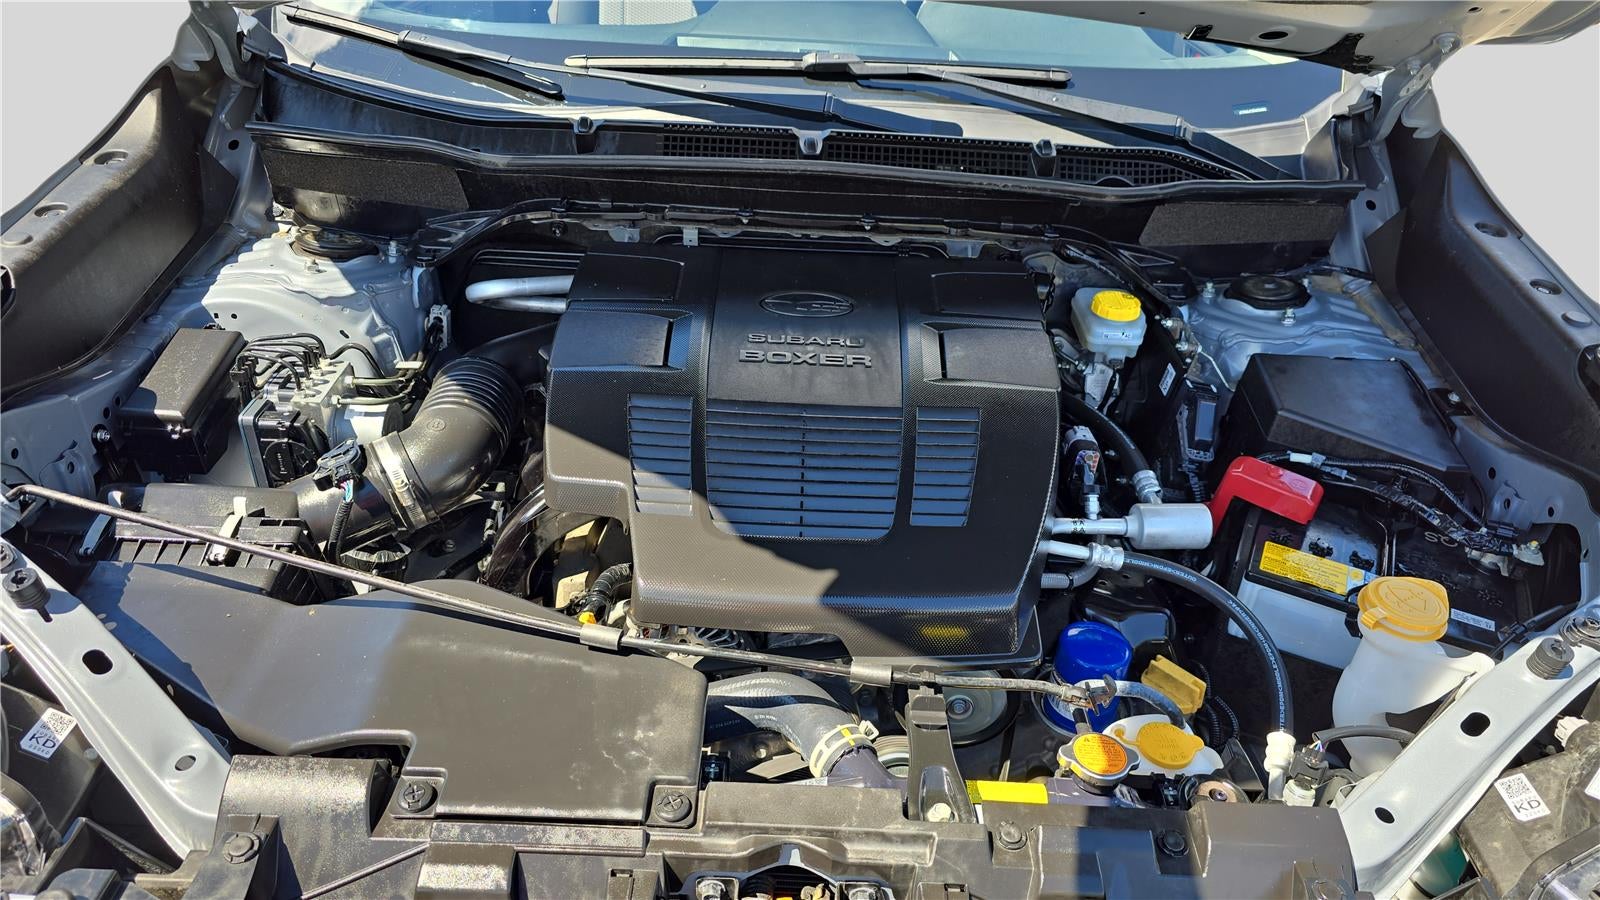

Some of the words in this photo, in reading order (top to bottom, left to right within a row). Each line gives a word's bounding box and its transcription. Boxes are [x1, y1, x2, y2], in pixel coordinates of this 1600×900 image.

[747, 333, 865, 348] SUBARU
[739, 349, 872, 368] BOXER
[28, 733, 56, 749] KD
[1513, 799, 1541, 813] KD
